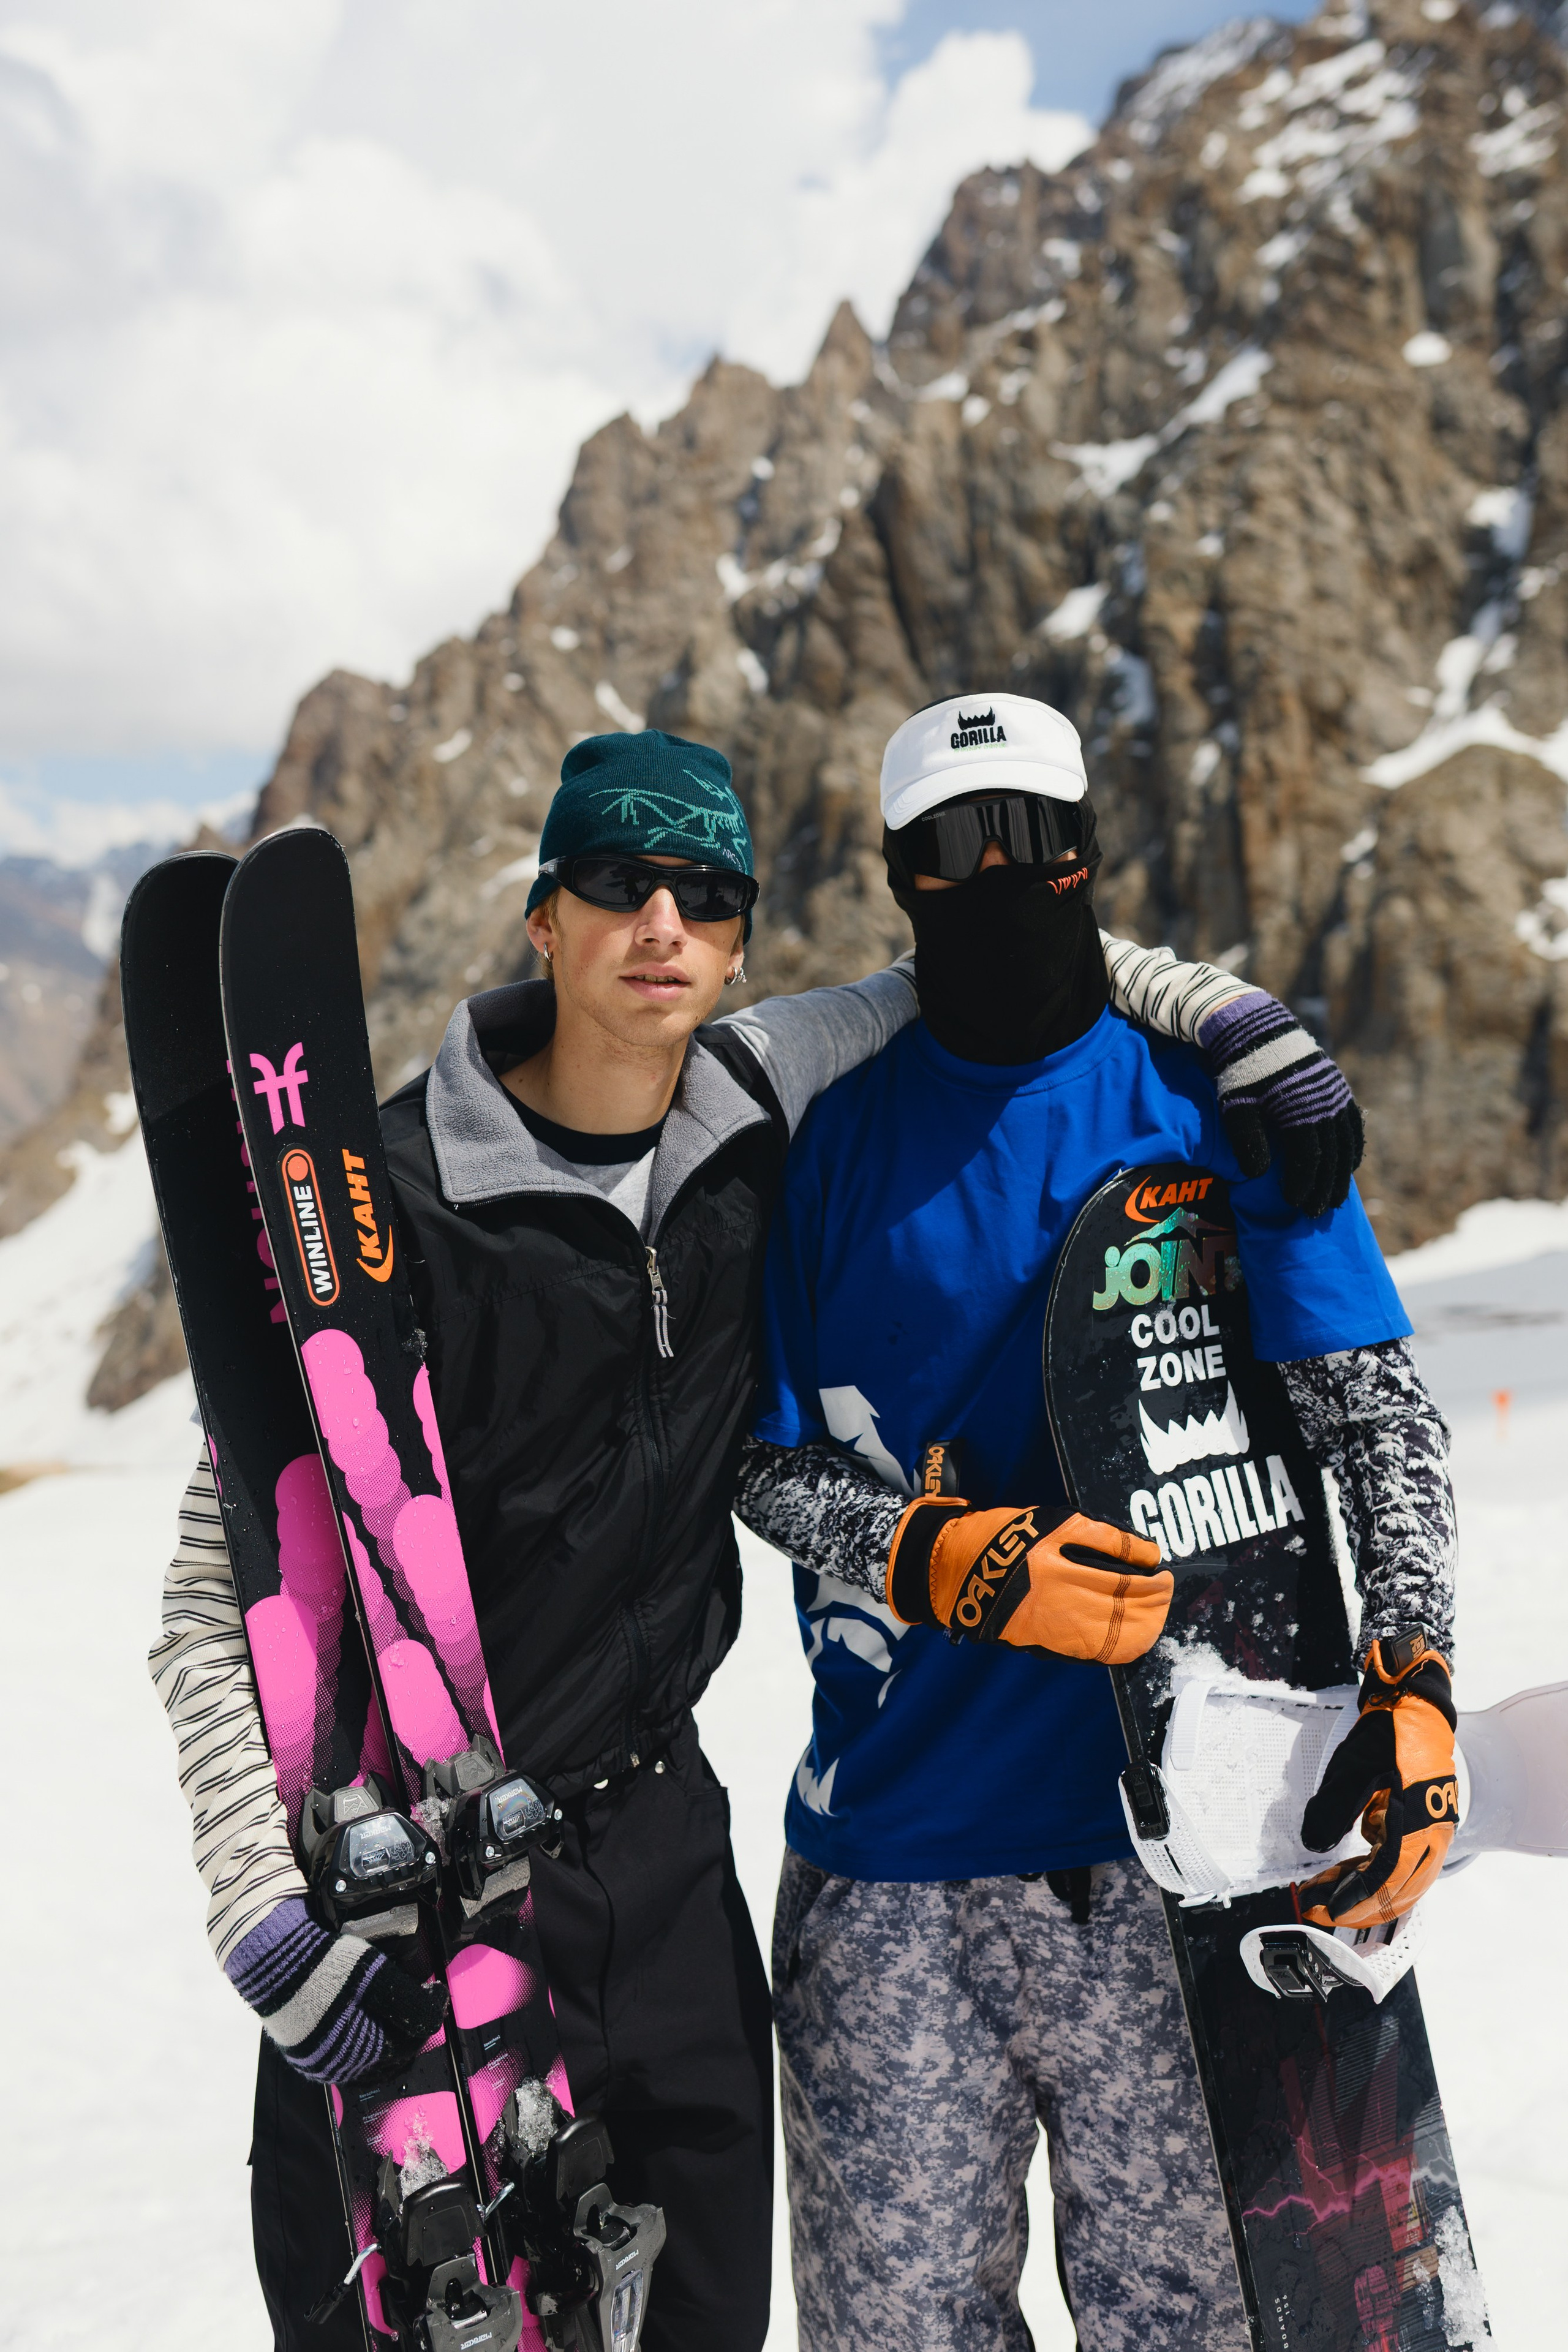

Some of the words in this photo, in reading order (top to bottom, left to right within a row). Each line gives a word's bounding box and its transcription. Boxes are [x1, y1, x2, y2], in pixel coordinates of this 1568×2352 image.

[951, 725, 1006, 749] GORILLA
[921, 811, 946, 822] COOLZONE
[294, 1185, 333, 1294] WINLINE
[1130, 1305, 1219, 1348] COOL
[1137, 1344, 1226, 1392] ZONE
[1129, 1455, 1305, 1562] GORILLA
[956, 1511, 1039, 1627] OAKLEY
[497, 1786, 523, 1803] MARKER
[360, 1825, 391, 1839] MARKER
[616, 2249, 639, 2271] MARKER
[1275, 2297, 1289, 2349] BOARDS
[461, 2331, 492, 2350] MARKER
